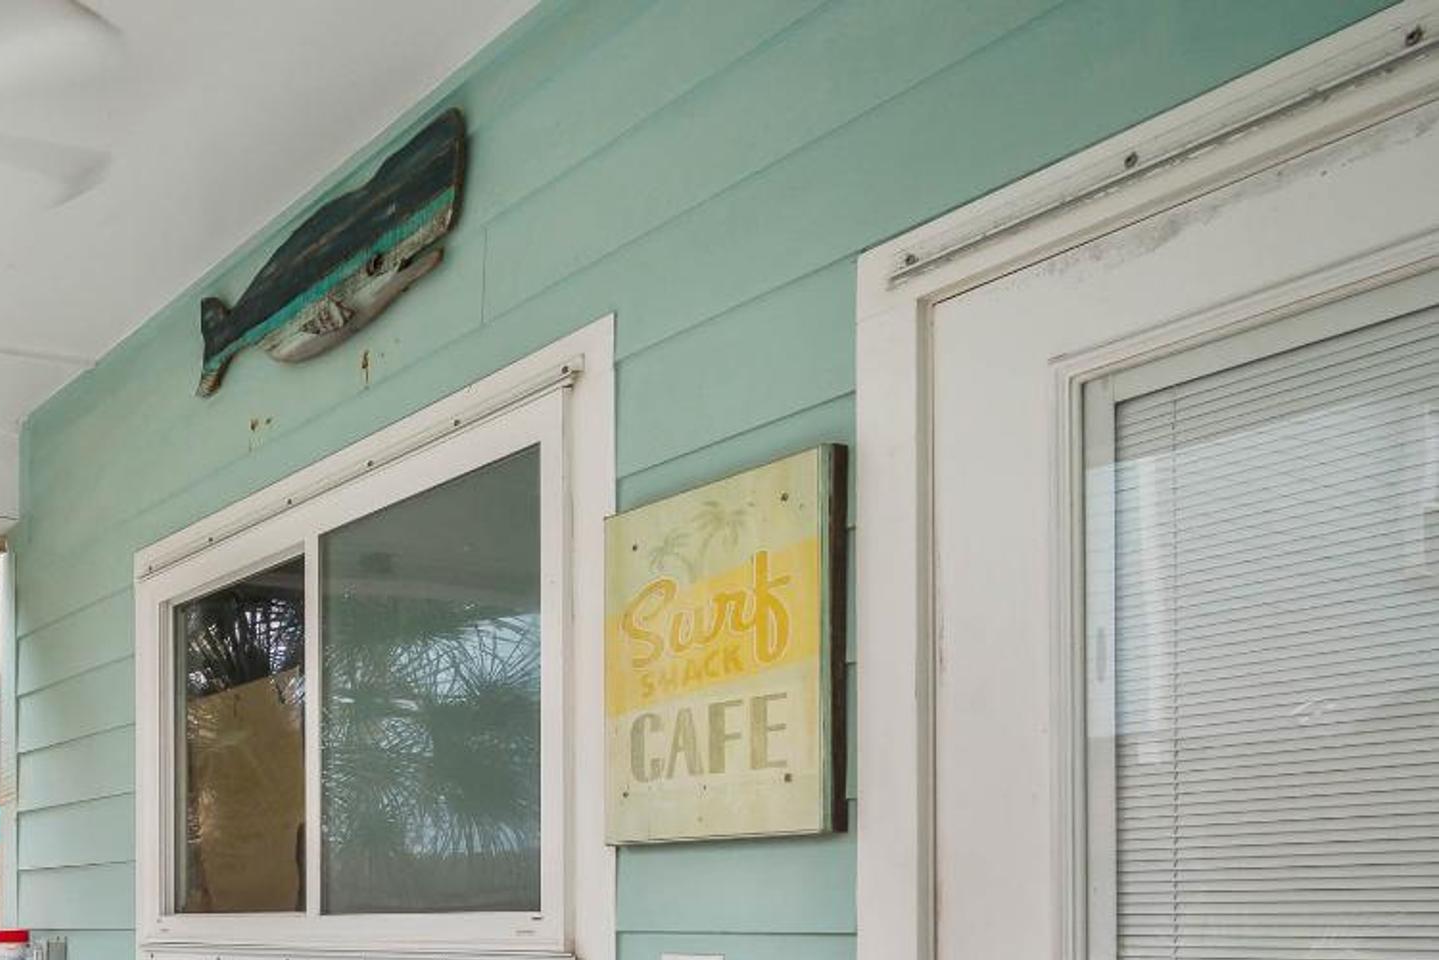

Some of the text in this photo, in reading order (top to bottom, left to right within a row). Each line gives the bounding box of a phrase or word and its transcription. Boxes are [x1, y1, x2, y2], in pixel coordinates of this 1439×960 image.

[622, 549, 792, 669] Surf
[641, 645, 746, 698] SHACK
[629, 692, 789, 784] CAFE
